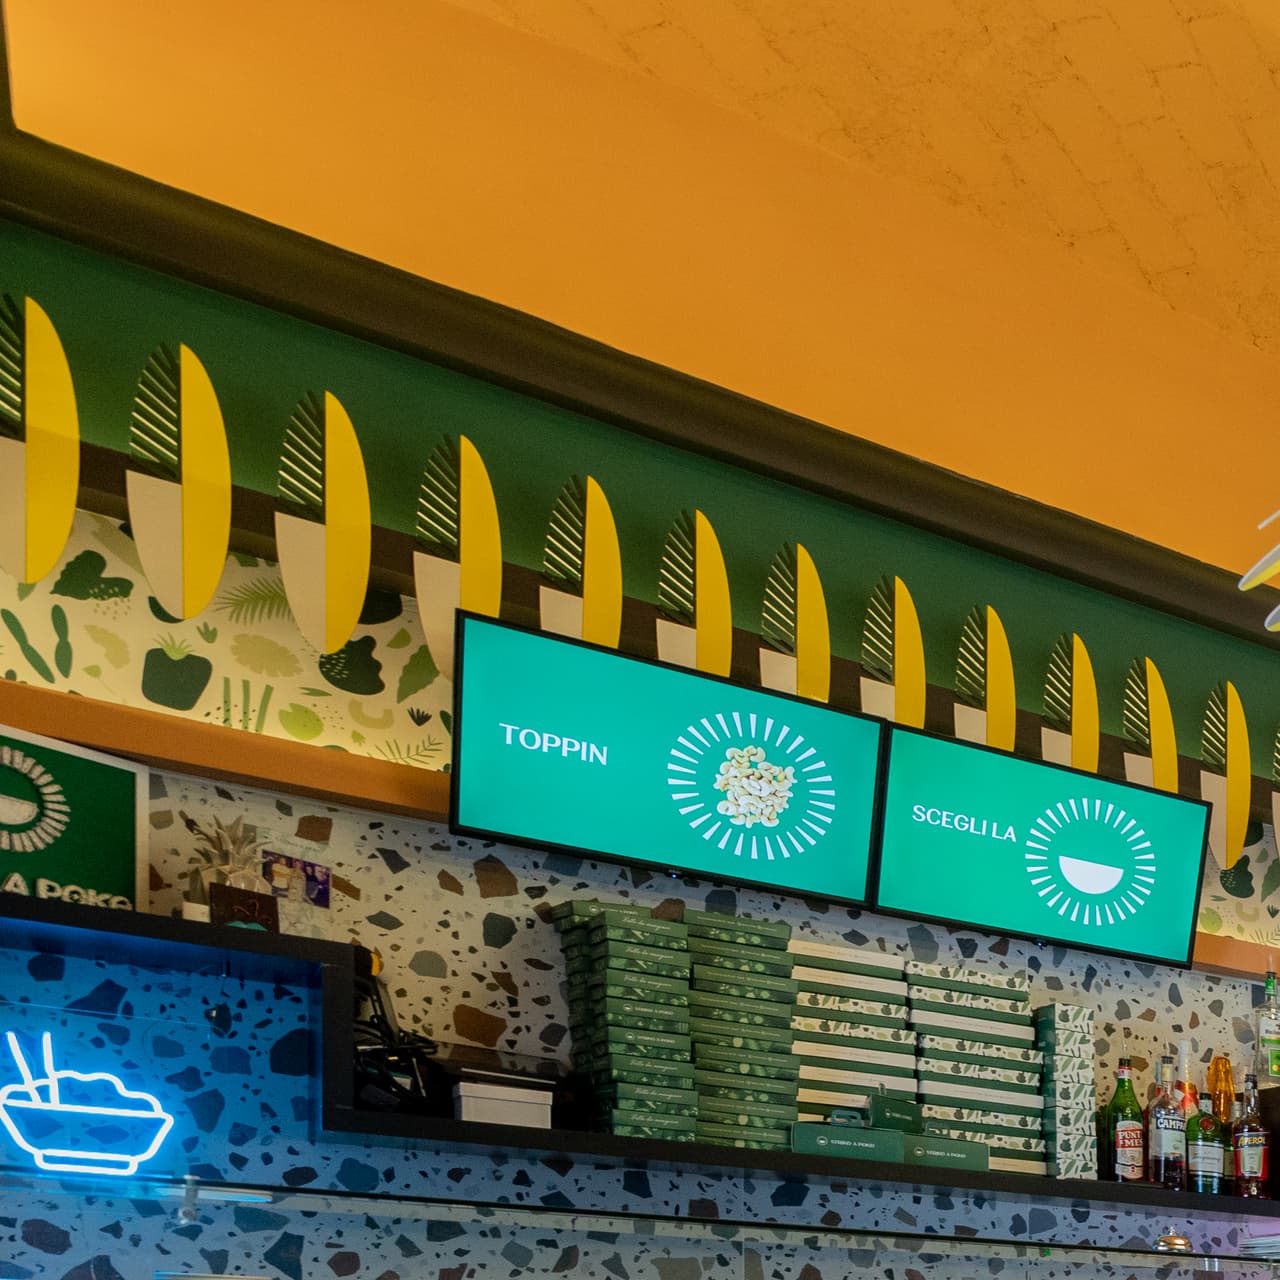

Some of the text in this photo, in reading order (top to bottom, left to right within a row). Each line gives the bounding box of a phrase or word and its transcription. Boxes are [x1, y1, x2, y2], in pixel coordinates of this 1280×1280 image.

[499, 722, 608, 766] TOPPIN
[912, 804, 1017, 843] SCEGLI LA
